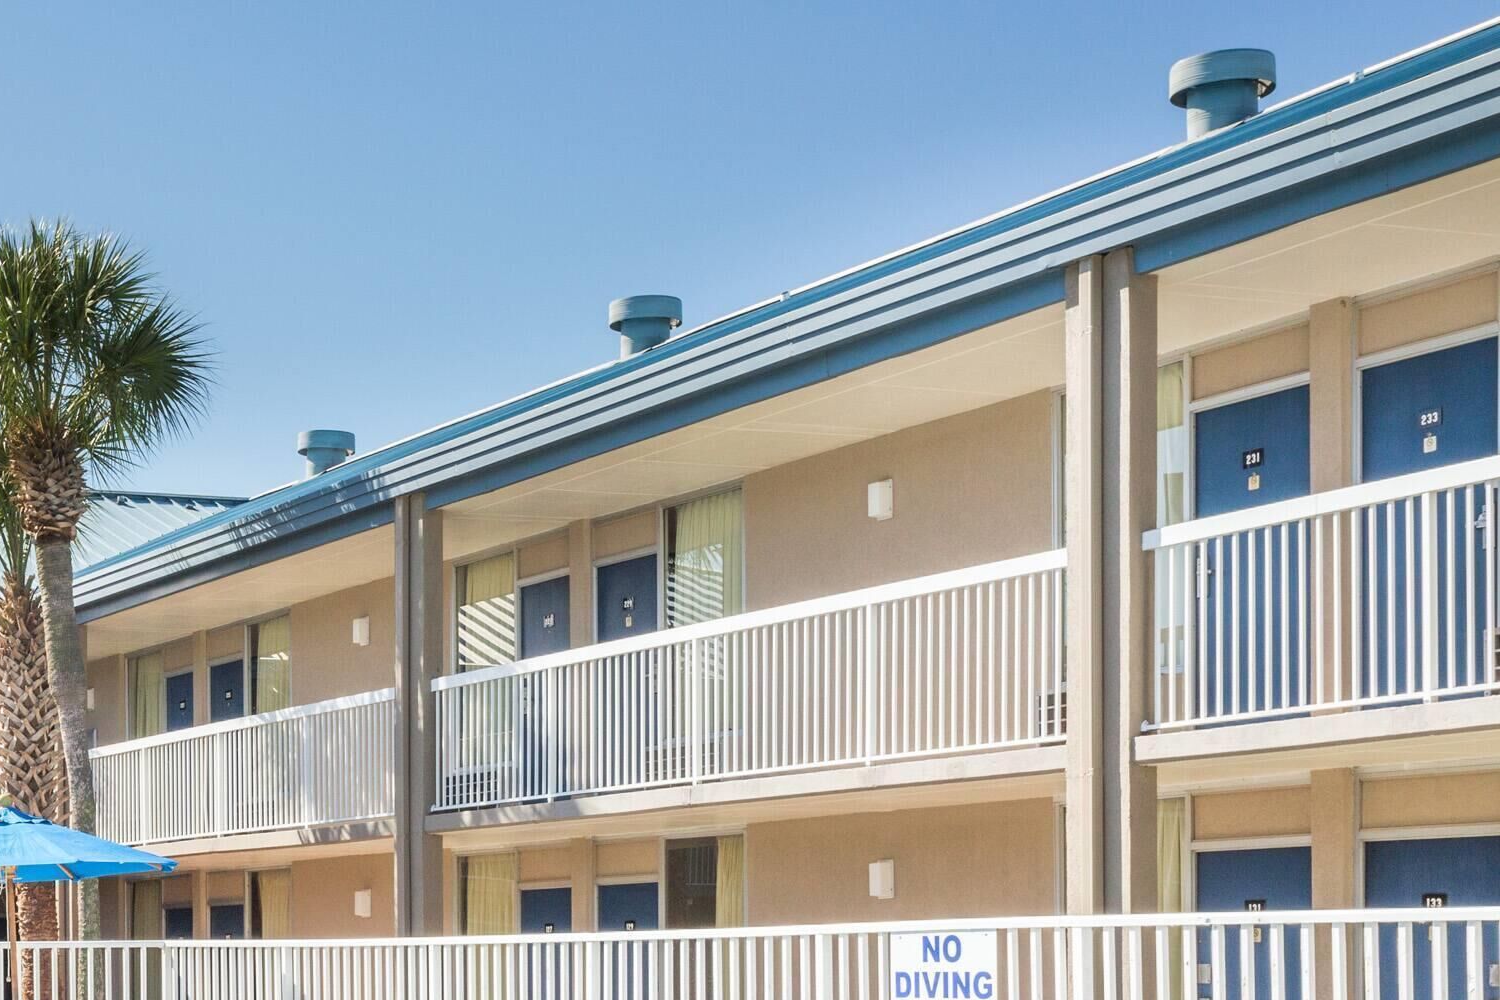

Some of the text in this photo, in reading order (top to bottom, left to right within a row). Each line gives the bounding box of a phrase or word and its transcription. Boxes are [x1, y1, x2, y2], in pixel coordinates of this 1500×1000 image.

[1421, 411, 1438, 426] 233
[1246, 452, 1260, 465] 231
[922, 935, 962, 963] NO
[895, 971, 993, 999] DIVING
